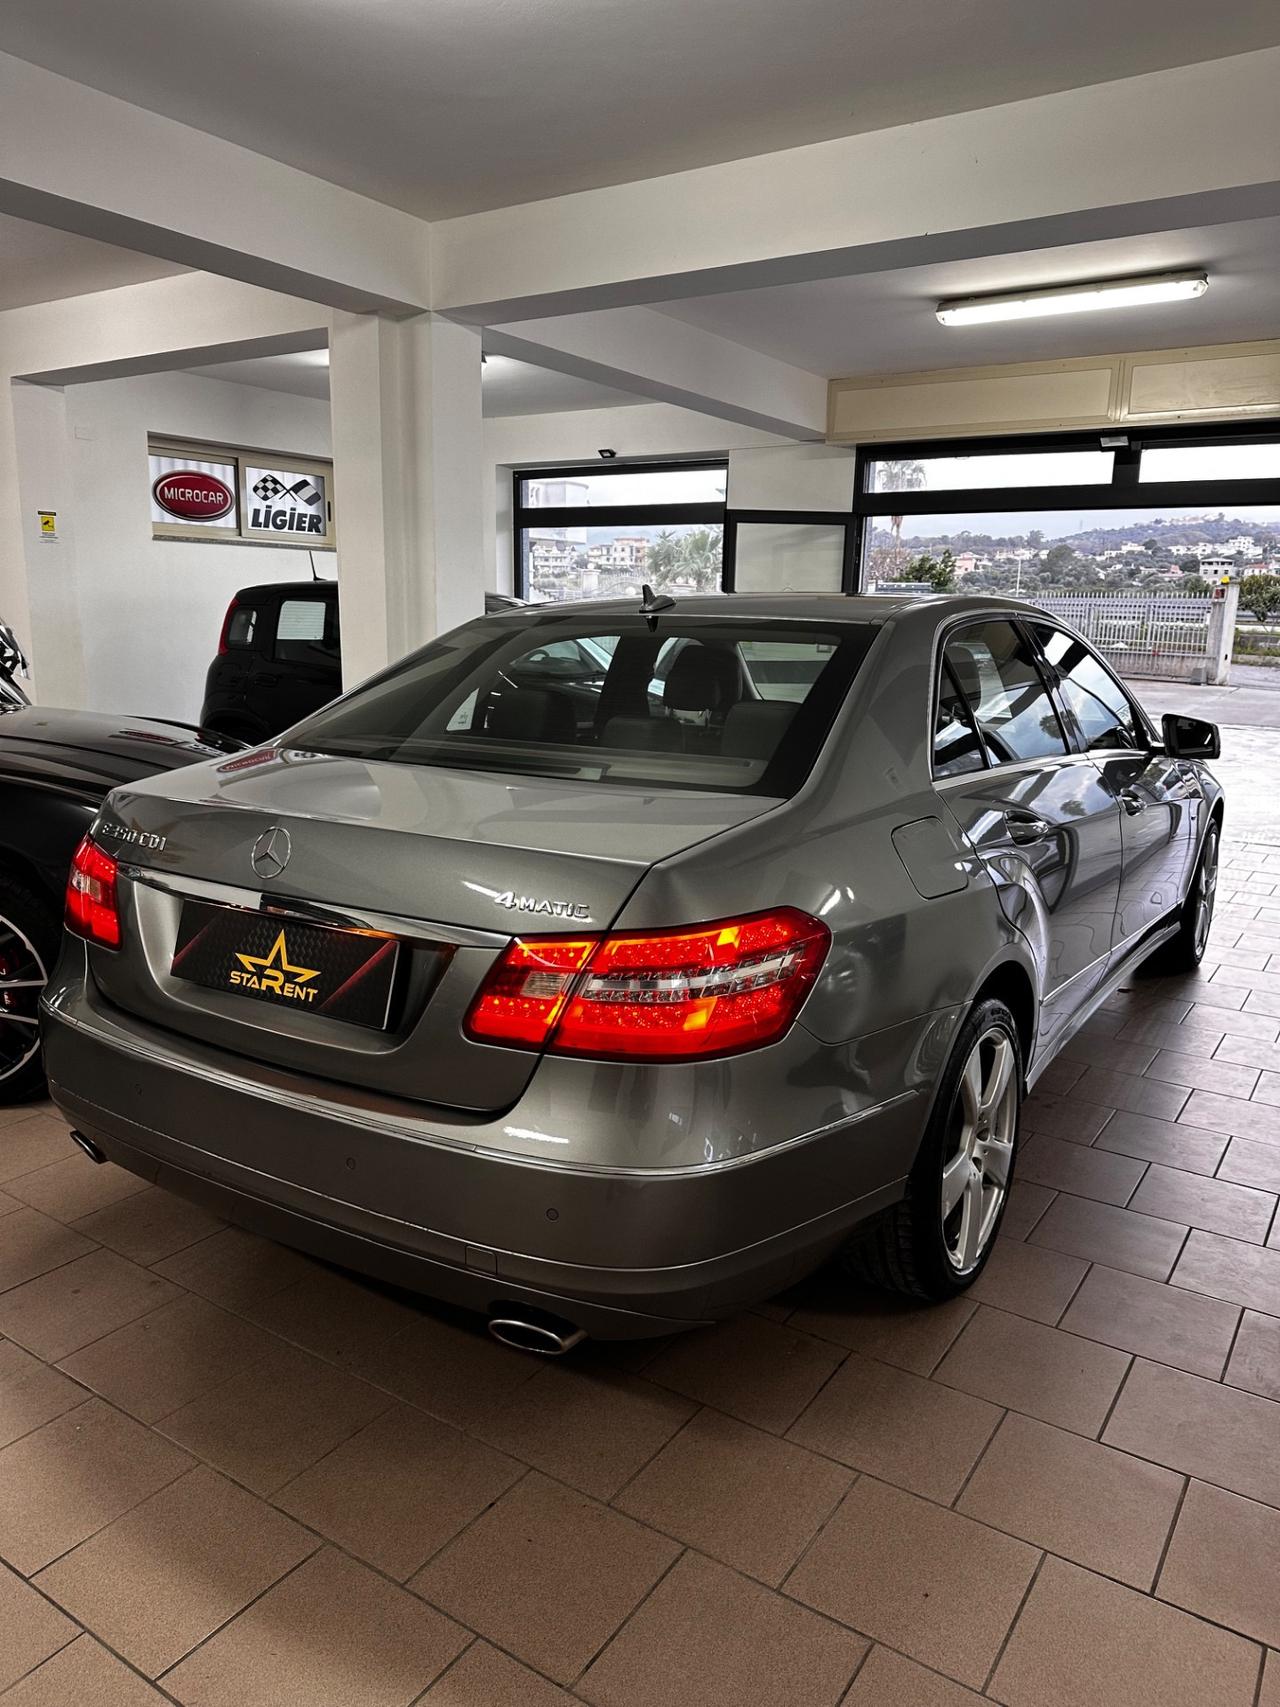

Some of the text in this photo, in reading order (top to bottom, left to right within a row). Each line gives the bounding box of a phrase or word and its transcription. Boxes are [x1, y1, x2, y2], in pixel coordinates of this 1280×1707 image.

[163, 486, 225, 505] MICROCAR
[138, 832, 167, 851] CDI
[494, 891, 590, 919] 4MATIC
